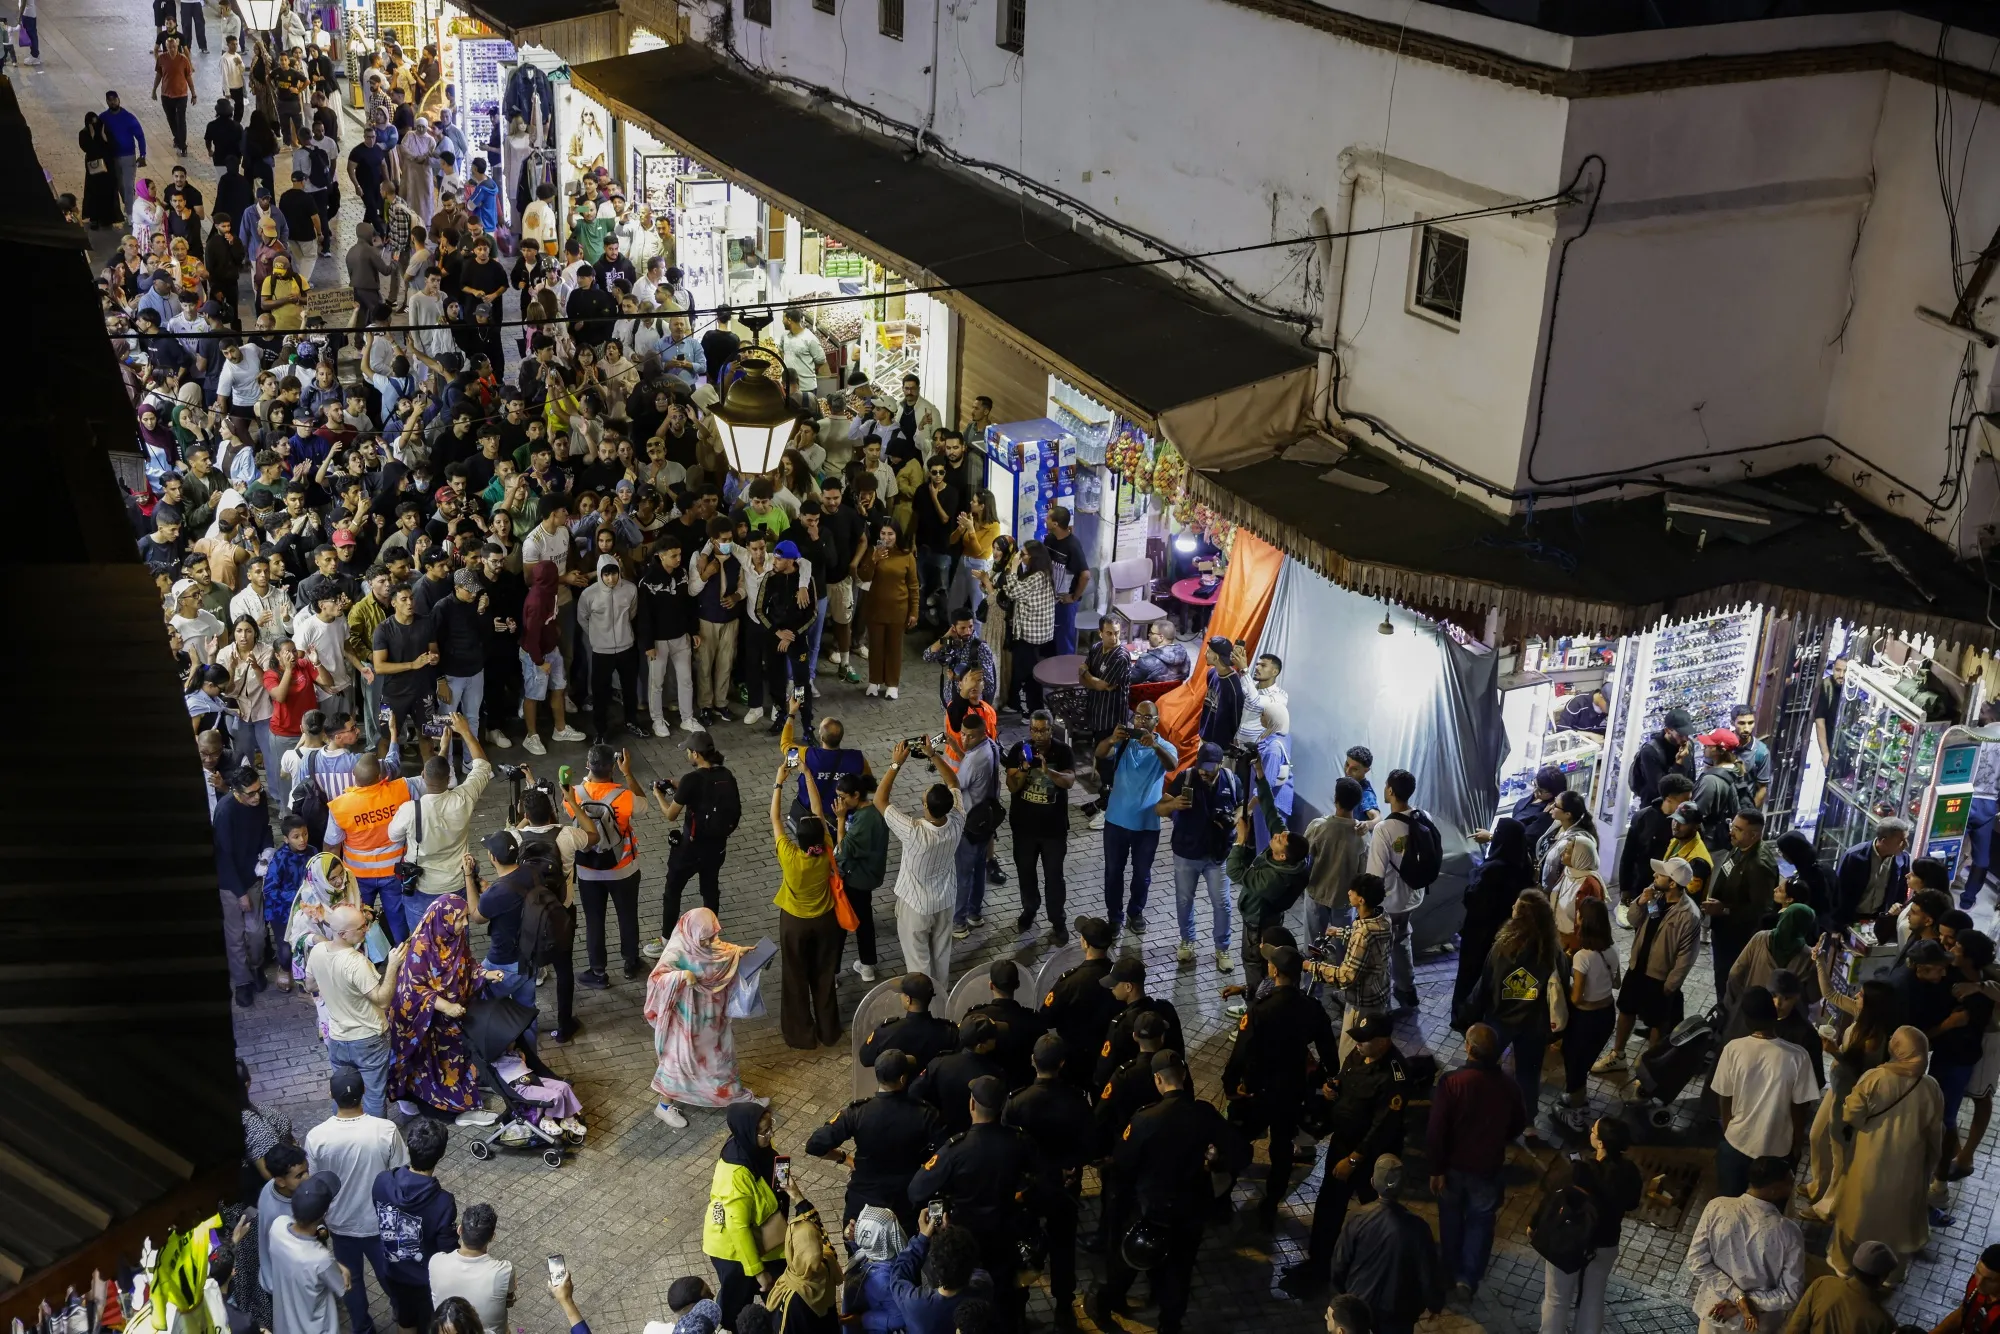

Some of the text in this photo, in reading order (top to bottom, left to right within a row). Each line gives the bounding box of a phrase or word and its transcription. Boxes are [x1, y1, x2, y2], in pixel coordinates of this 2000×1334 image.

[817, 772, 850, 781] PRES
[1023, 790, 1048, 804] TREES
[353, 804, 396, 827] PRESSE
